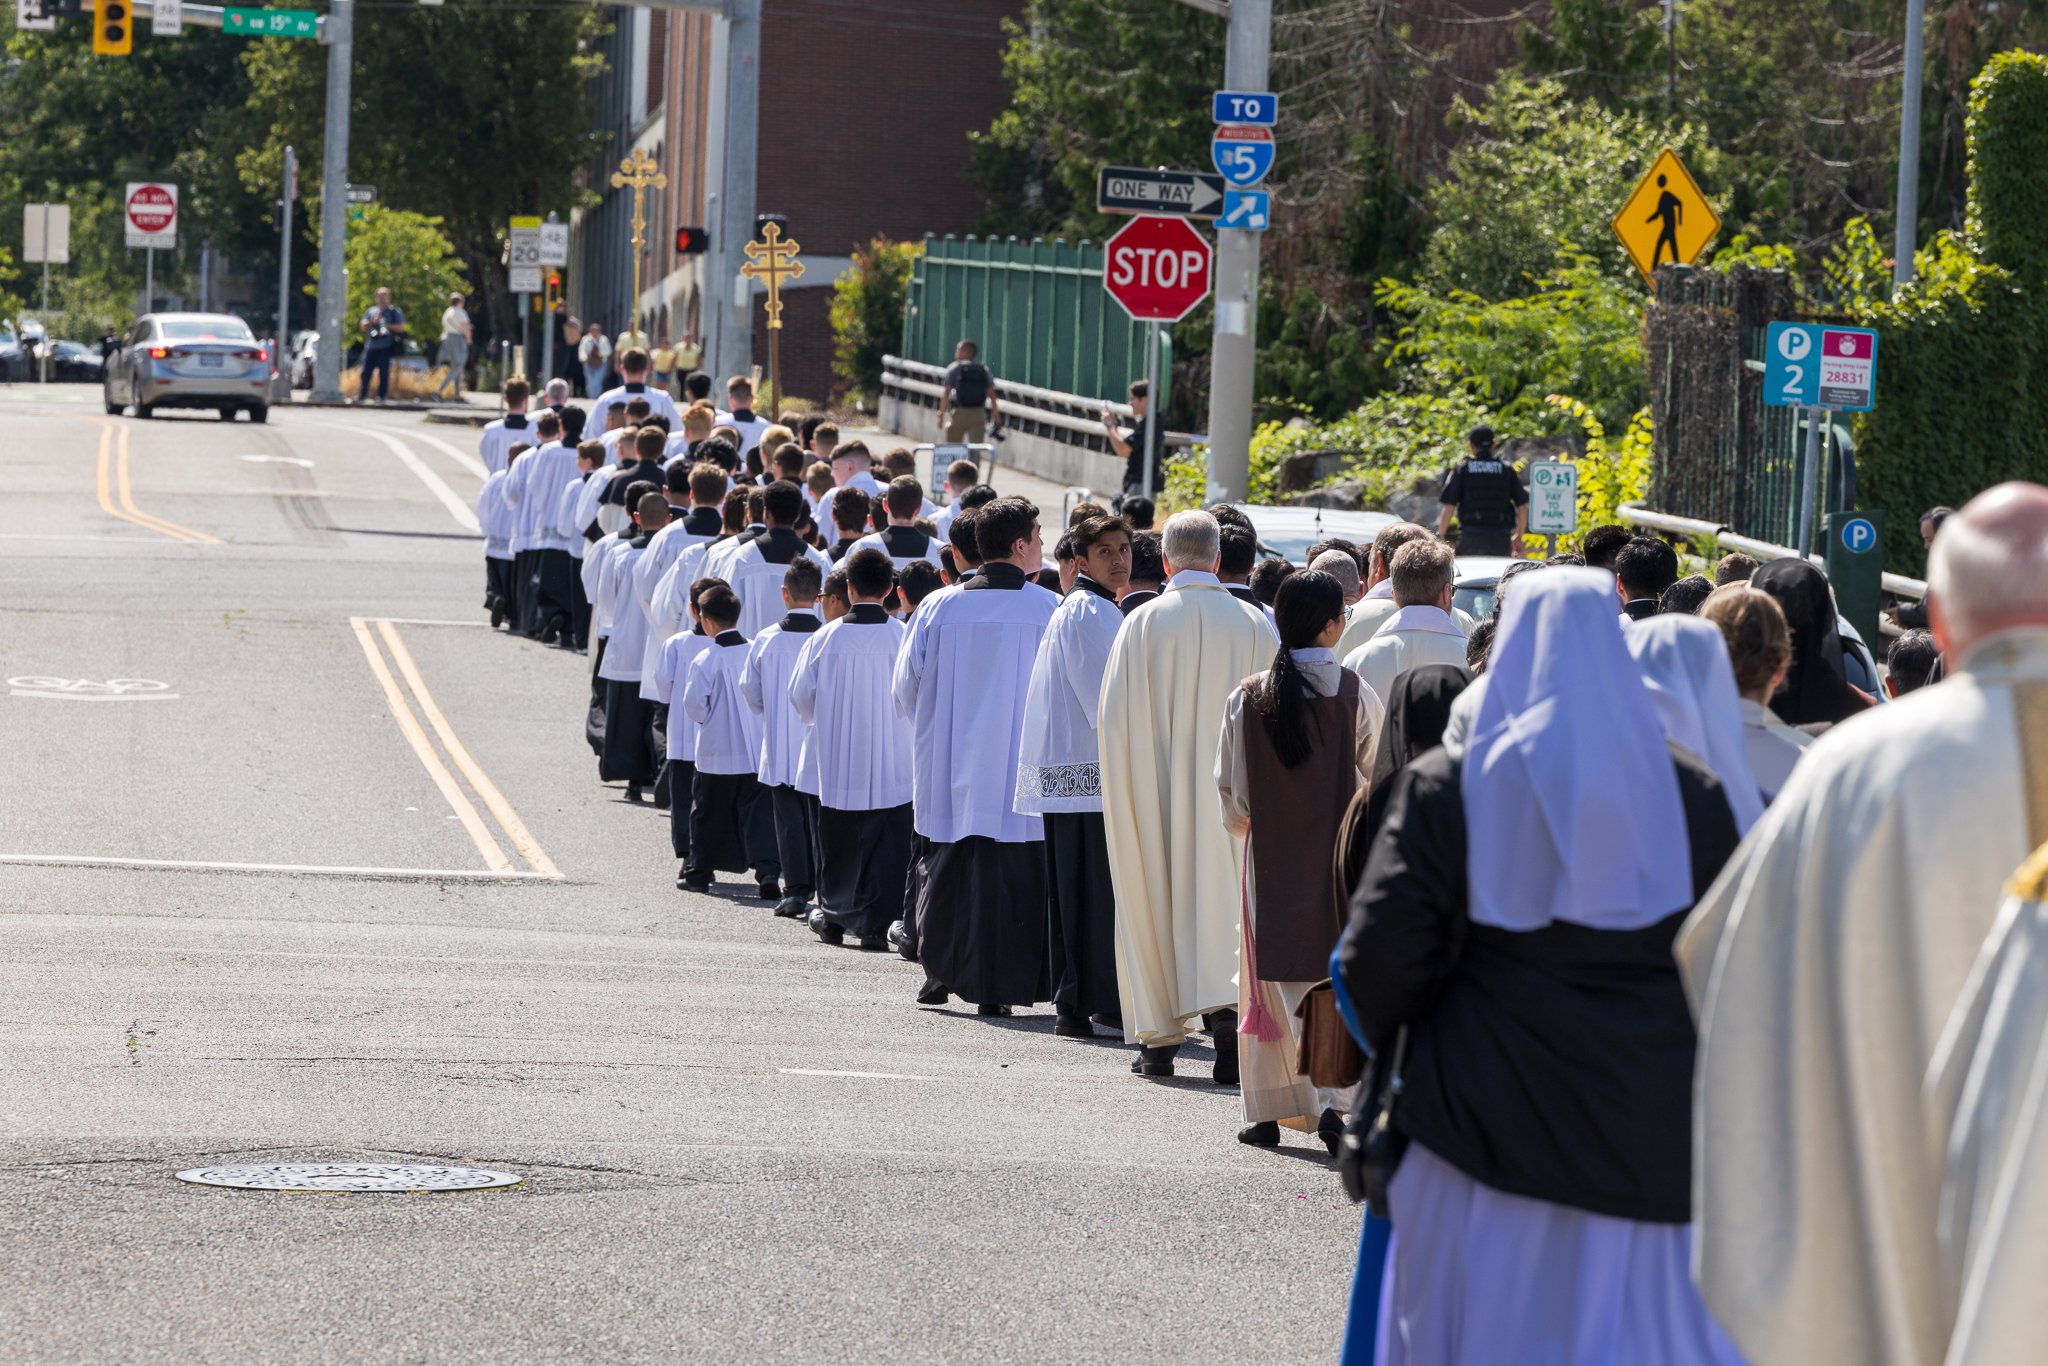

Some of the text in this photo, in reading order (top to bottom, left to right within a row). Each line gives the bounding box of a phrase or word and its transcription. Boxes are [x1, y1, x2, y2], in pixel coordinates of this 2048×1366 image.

[1230, 98, 1261, 118] TO
[1234, 146, 1256, 180] 5
[134, 193, 168, 203] DO NOT
[1111, 180, 1195, 202] ONE WAY
[136, 215, 166, 225] ENTER
[514, 247, 539, 263] 20
[1112, 246, 1204, 288] STOP
[1788, 332, 1804, 355] P
[1782, 364, 1804, 394] 2
[1826, 371, 1863, 384] 28831
[1468, 461, 1502, 473] SECURITY
[1545, 492, 1562, 501] PAY
[1548, 501, 1560, 510] TO
[1541, 510, 1565, 519] PARK
[1852, 525, 1868, 548] P
